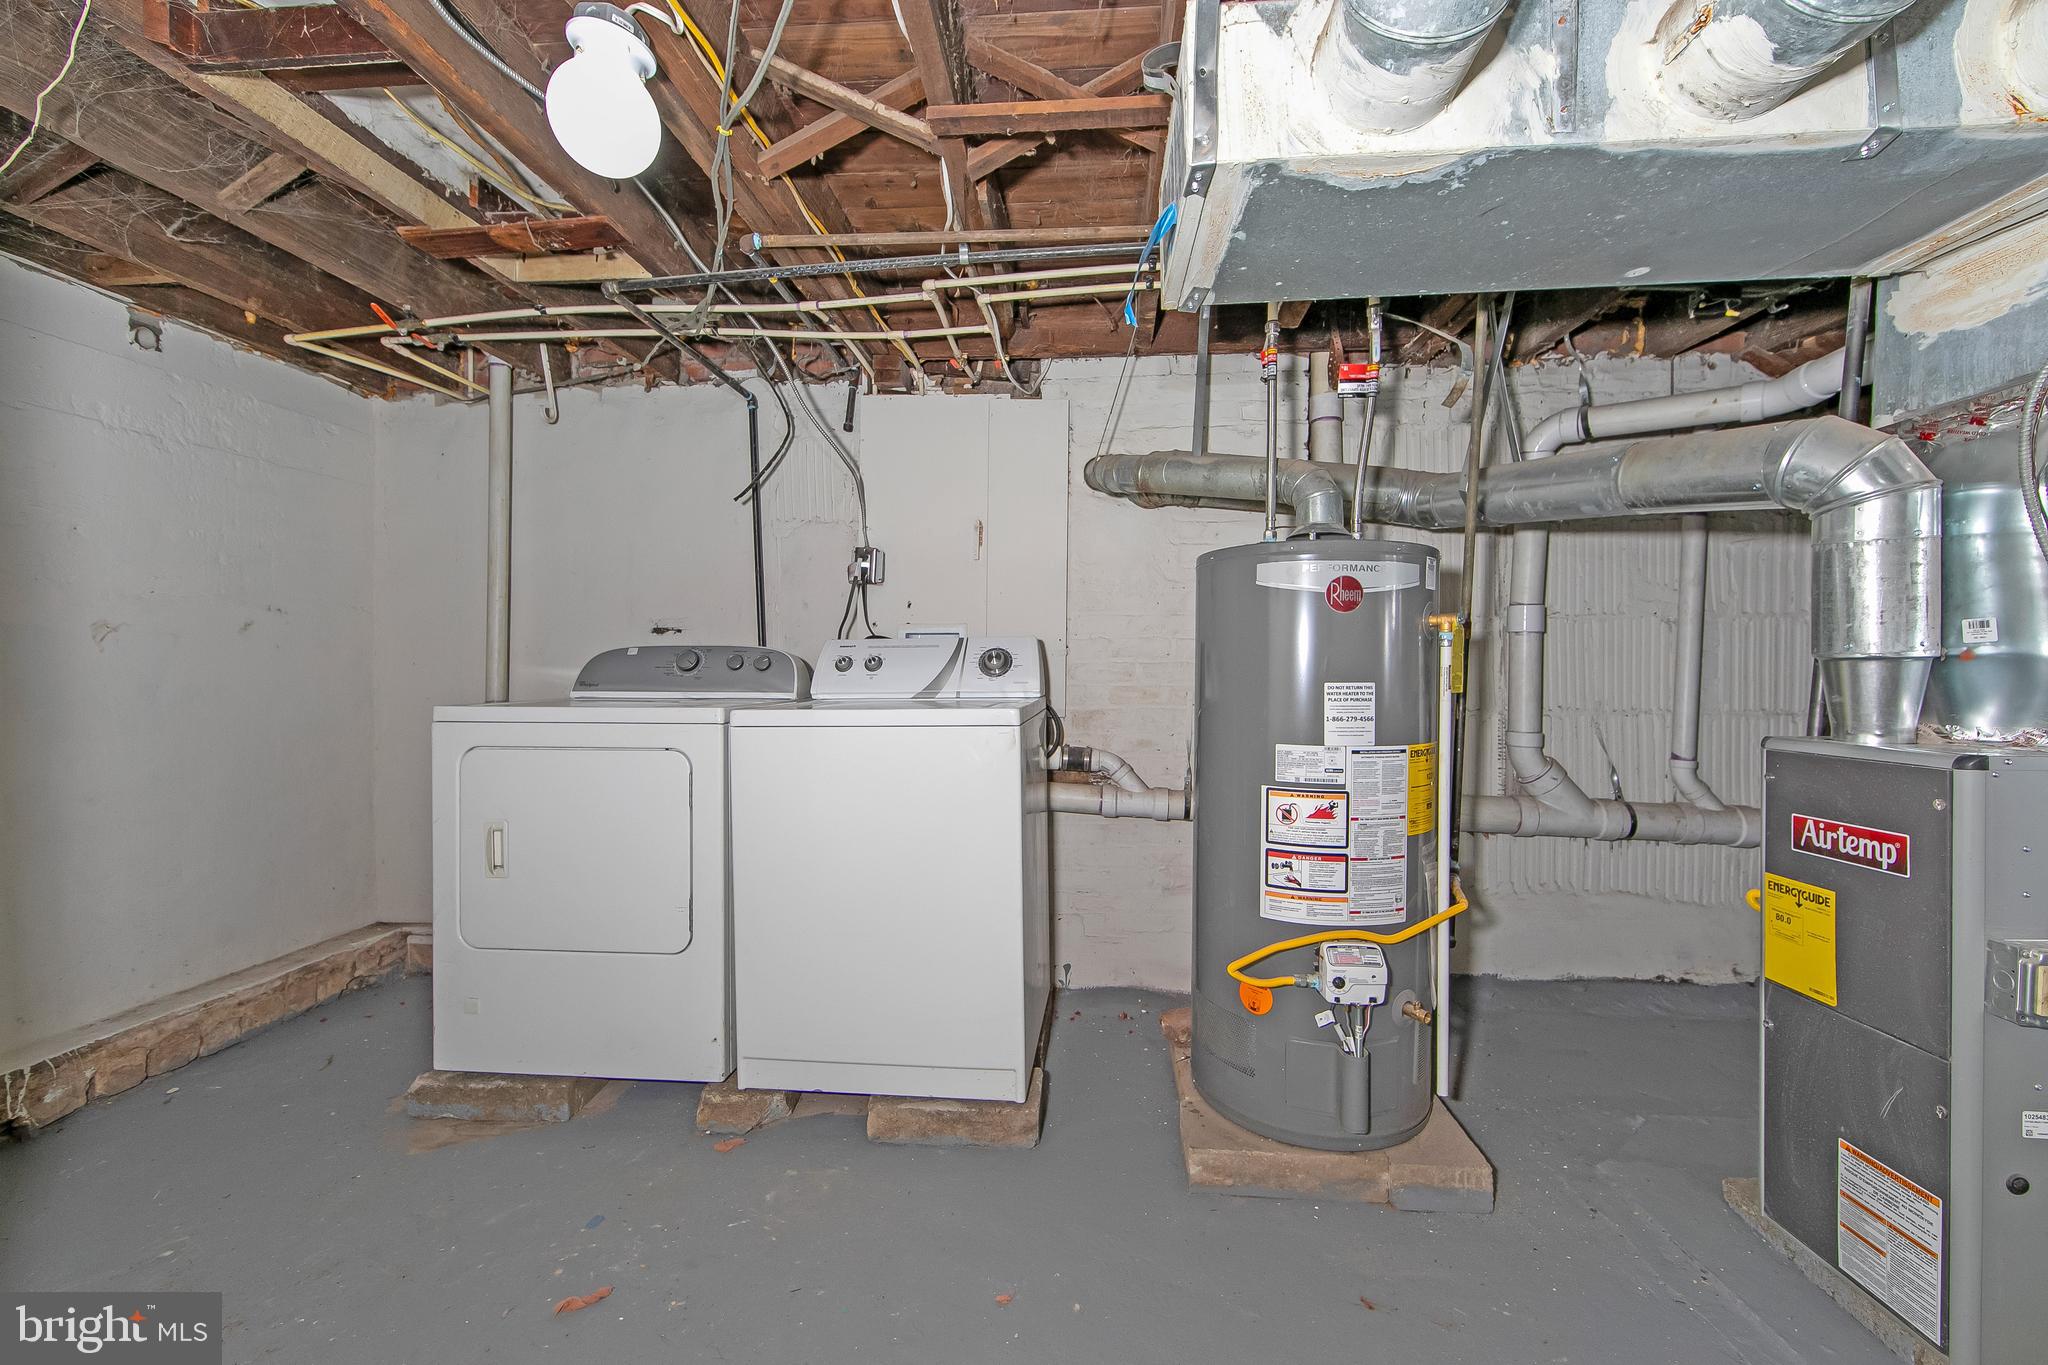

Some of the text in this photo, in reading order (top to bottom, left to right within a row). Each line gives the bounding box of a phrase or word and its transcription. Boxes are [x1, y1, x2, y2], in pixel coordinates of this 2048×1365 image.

[1329, 576, 1363, 607] Rheem
[1767, 879, 1831, 908] ENERGYGUIDE
[1775, 912, 1792, 925] 80.0
